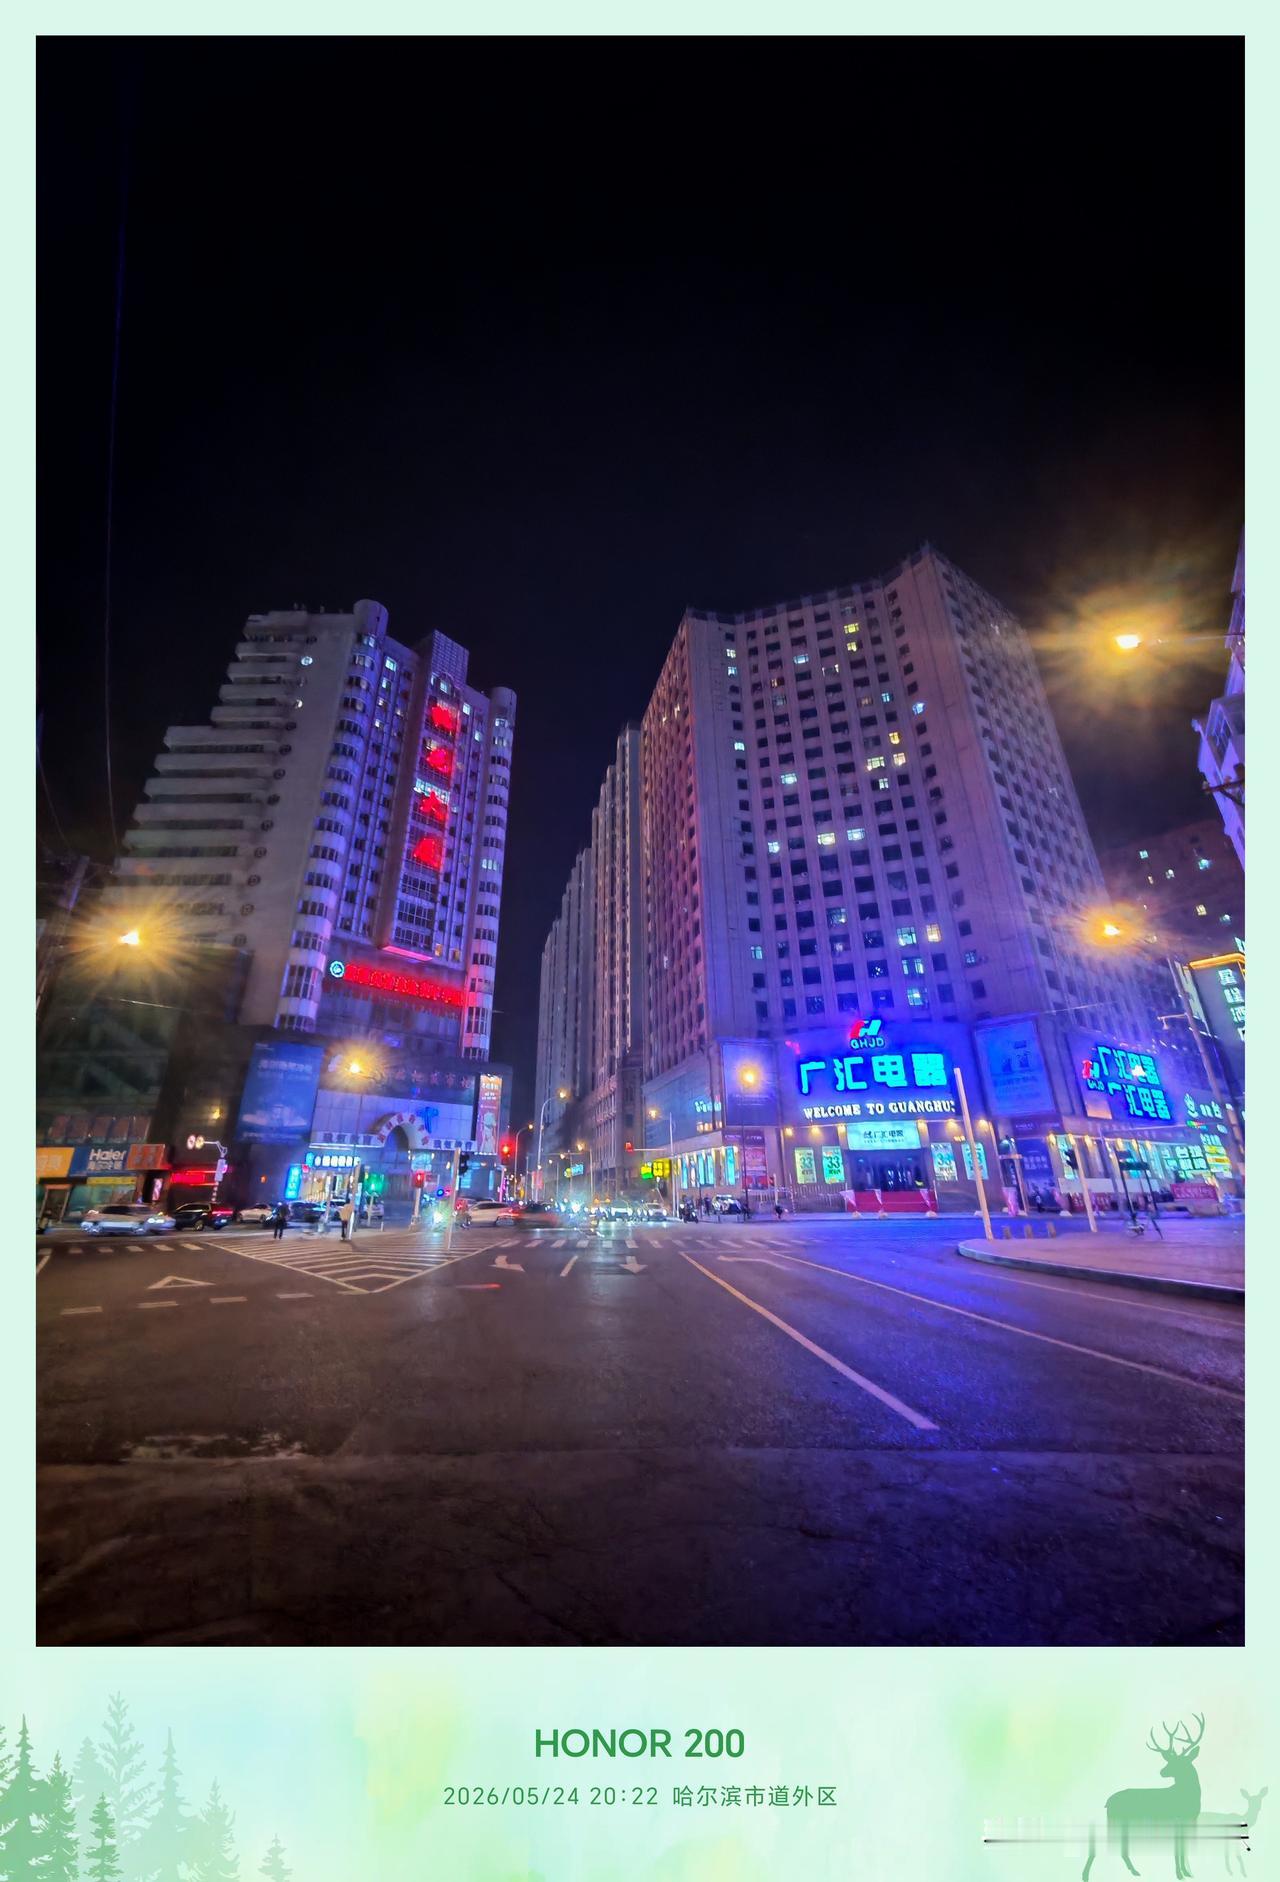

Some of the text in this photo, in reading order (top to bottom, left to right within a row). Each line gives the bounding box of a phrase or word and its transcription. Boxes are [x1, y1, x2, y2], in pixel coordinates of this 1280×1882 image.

[850, 1037, 884, 1050] GHJD
[800, 1053, 947, 1094] 广汇电器
[1097, 1046, 1160, 1085] 广汇电器
[1107, 1081, 1171, 1120] 广汇电器
[803, 1103, 861, 1120] WELCOME
[866, 1103, 885, 1116] TO
[89, 1148, 128, 1161] Haier
[824, 1155, 841, 1169] 33
